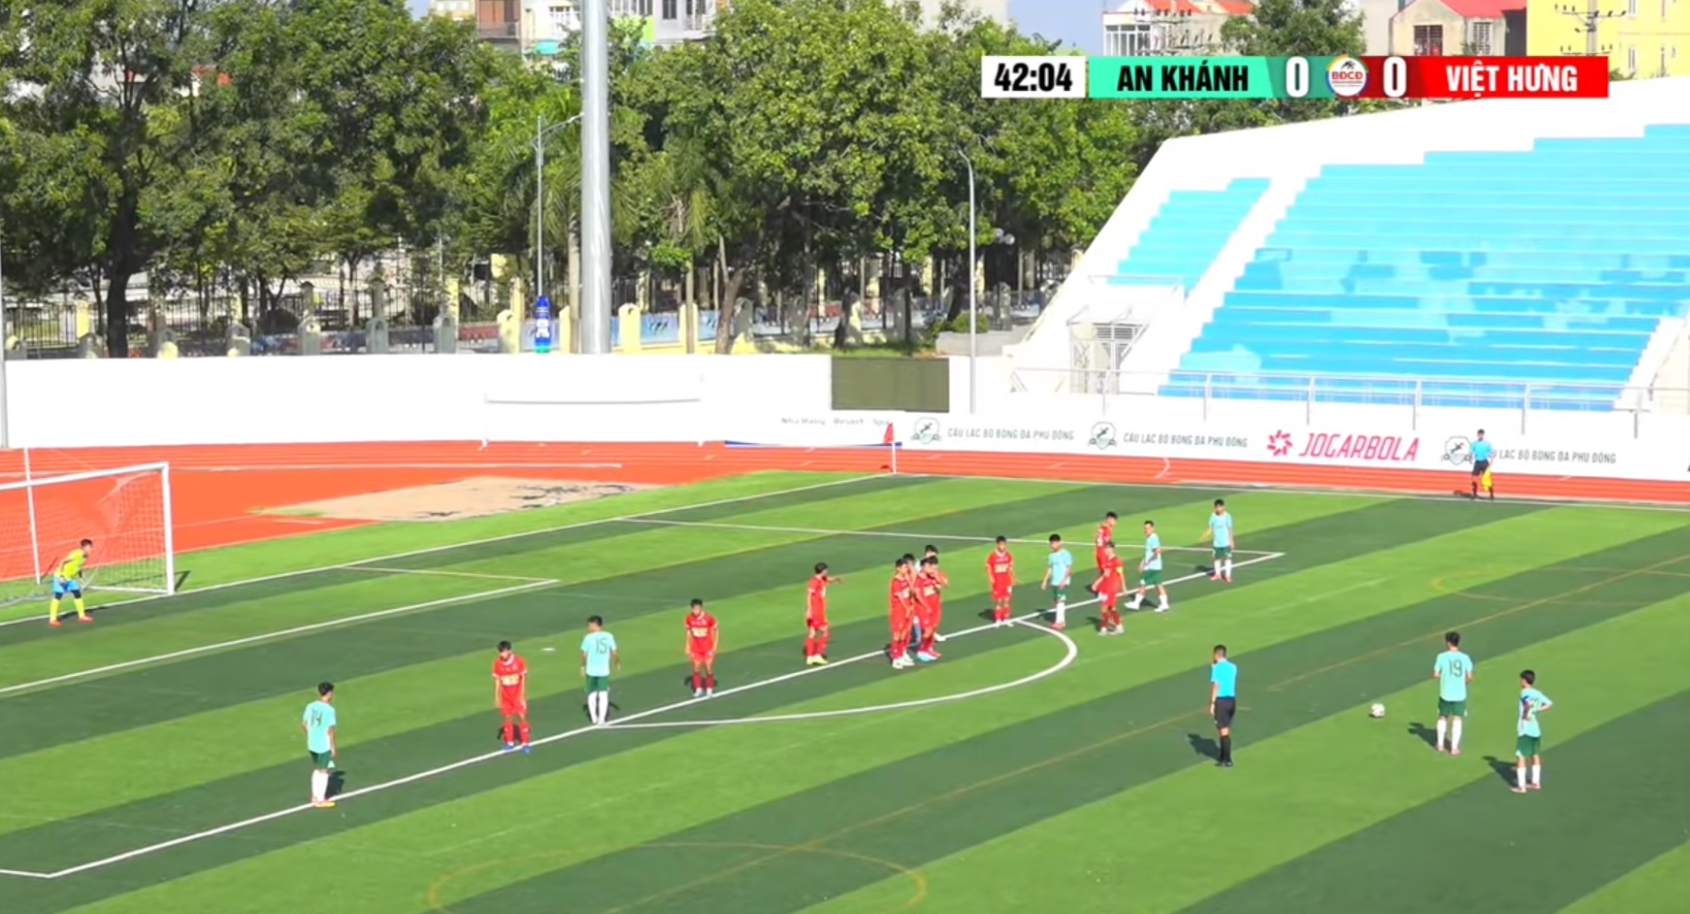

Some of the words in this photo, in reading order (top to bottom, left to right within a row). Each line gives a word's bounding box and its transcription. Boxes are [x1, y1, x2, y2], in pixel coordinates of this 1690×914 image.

[1298, 432, 1420, 462] JOGARBOLA
[594, 637, 607, 654] 15
[1448, 659, 1463, 678] 19
[310, 708, 323, 727] 14
